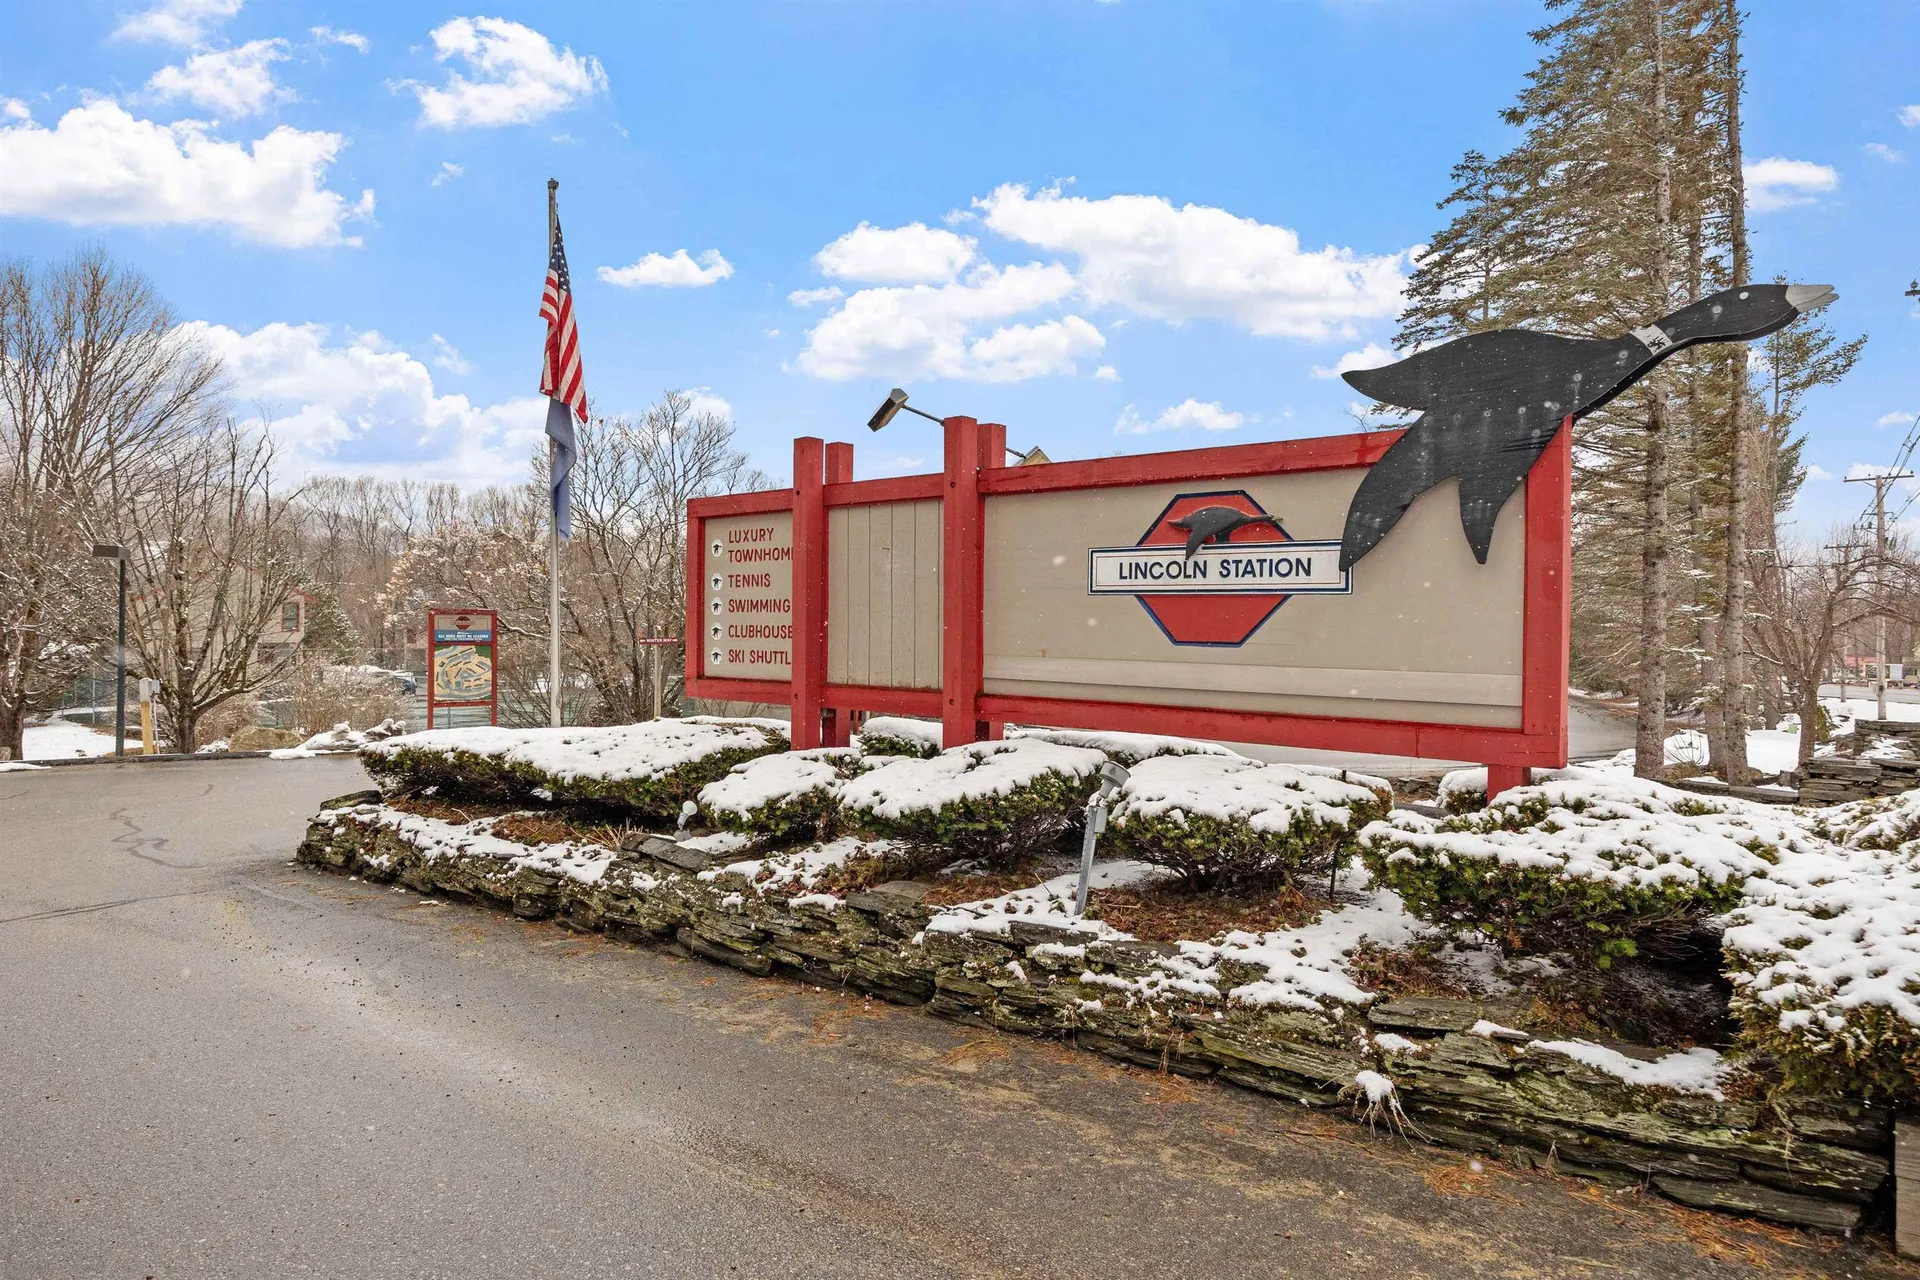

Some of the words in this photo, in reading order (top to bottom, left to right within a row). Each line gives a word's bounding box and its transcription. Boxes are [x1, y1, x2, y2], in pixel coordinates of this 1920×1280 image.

[729, 528, 774, 543] LUXURY
[728, 547, 793, 563] TOWNHOM
[1119, 560, 1208, 580] LINCOLN
[1219, 557, 1312, 579] STATION
[728, 573, 771, 588] TENNIS
[728, 598, 791, 613] SWIMMING
[728, 624, 793, 639] CLUBHOUSE
[728, 649, 745, 663] SKI
